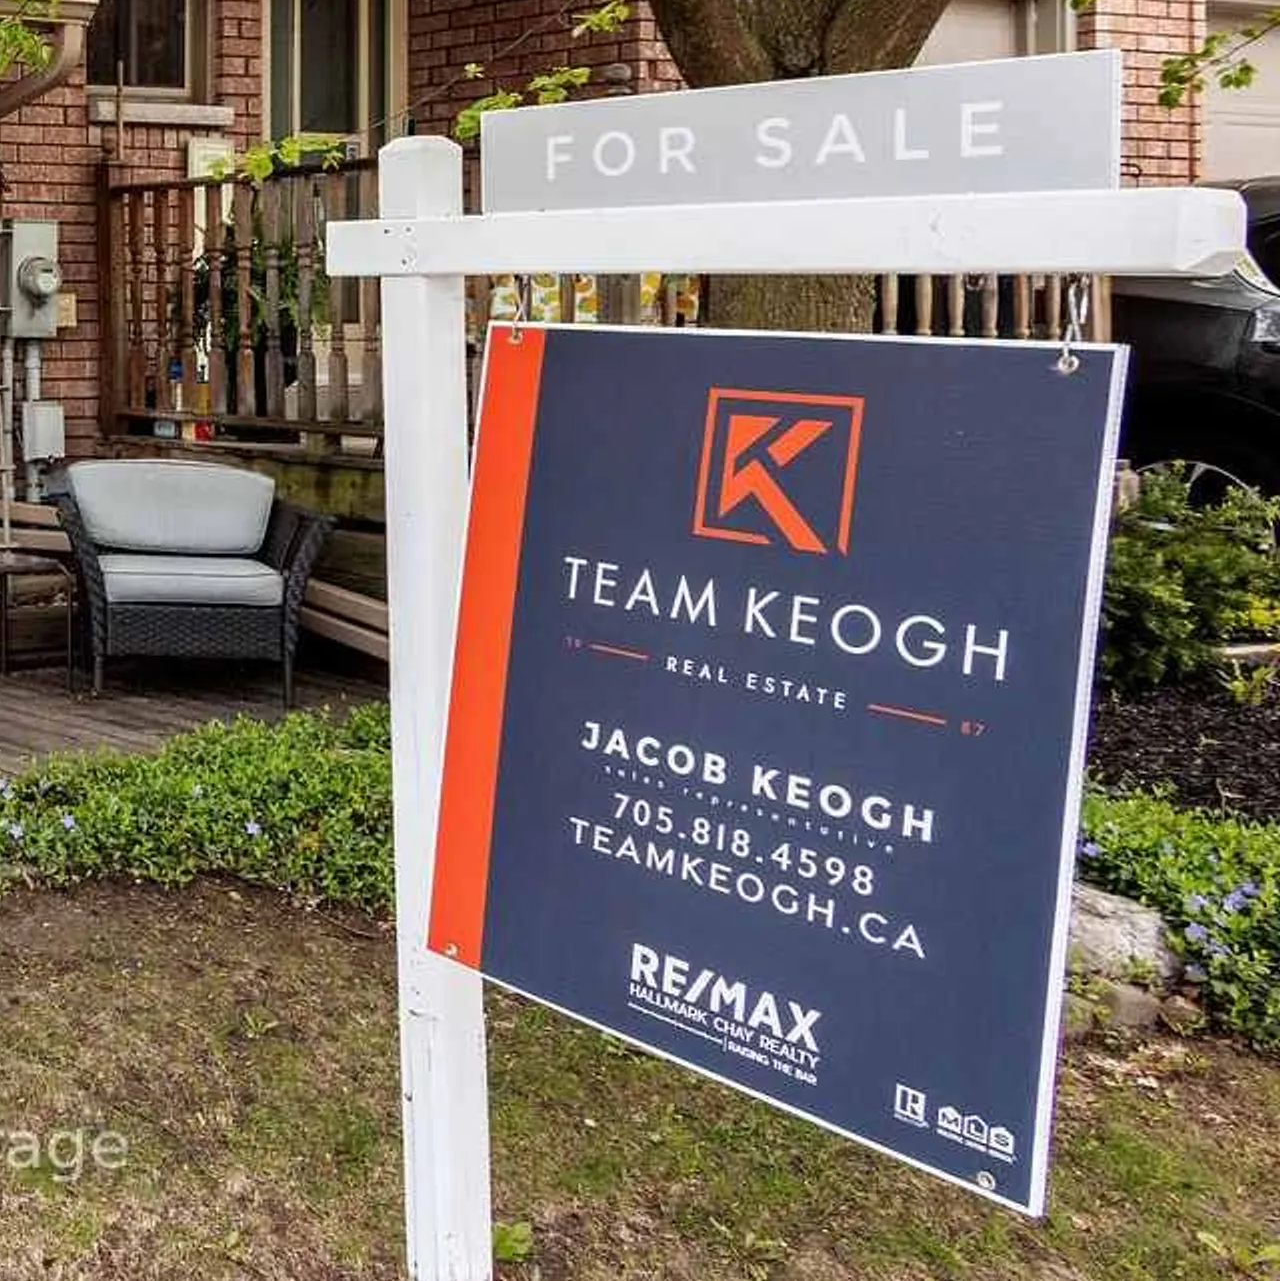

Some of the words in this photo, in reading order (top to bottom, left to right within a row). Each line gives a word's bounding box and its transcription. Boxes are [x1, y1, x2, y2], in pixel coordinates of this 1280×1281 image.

[547, 127, 695, 180] FOR
[756, 100, 1004, 168] SALE
[564, 556, 717, 627] TEAM
[744, 587, 1009, 681] KEOGH
[665, 656, 728, 684] REAL
[745, 672, 847, 710] ESTATE
[581, 721, 727, 785] JACOB
[751, 764, 934, 843] KEOGH
[569, 816, 926, 959] TEAMKEOGH.CA
[614, 792, 874, 896] 705.818.4598
[629, 982, 708, 1025] HALLMARK
[712, 1016, 756, 1043] CHAY
[759, 1034, 821, 1069] REALTY
[630, 942, 822, 1053] RE/MAX
